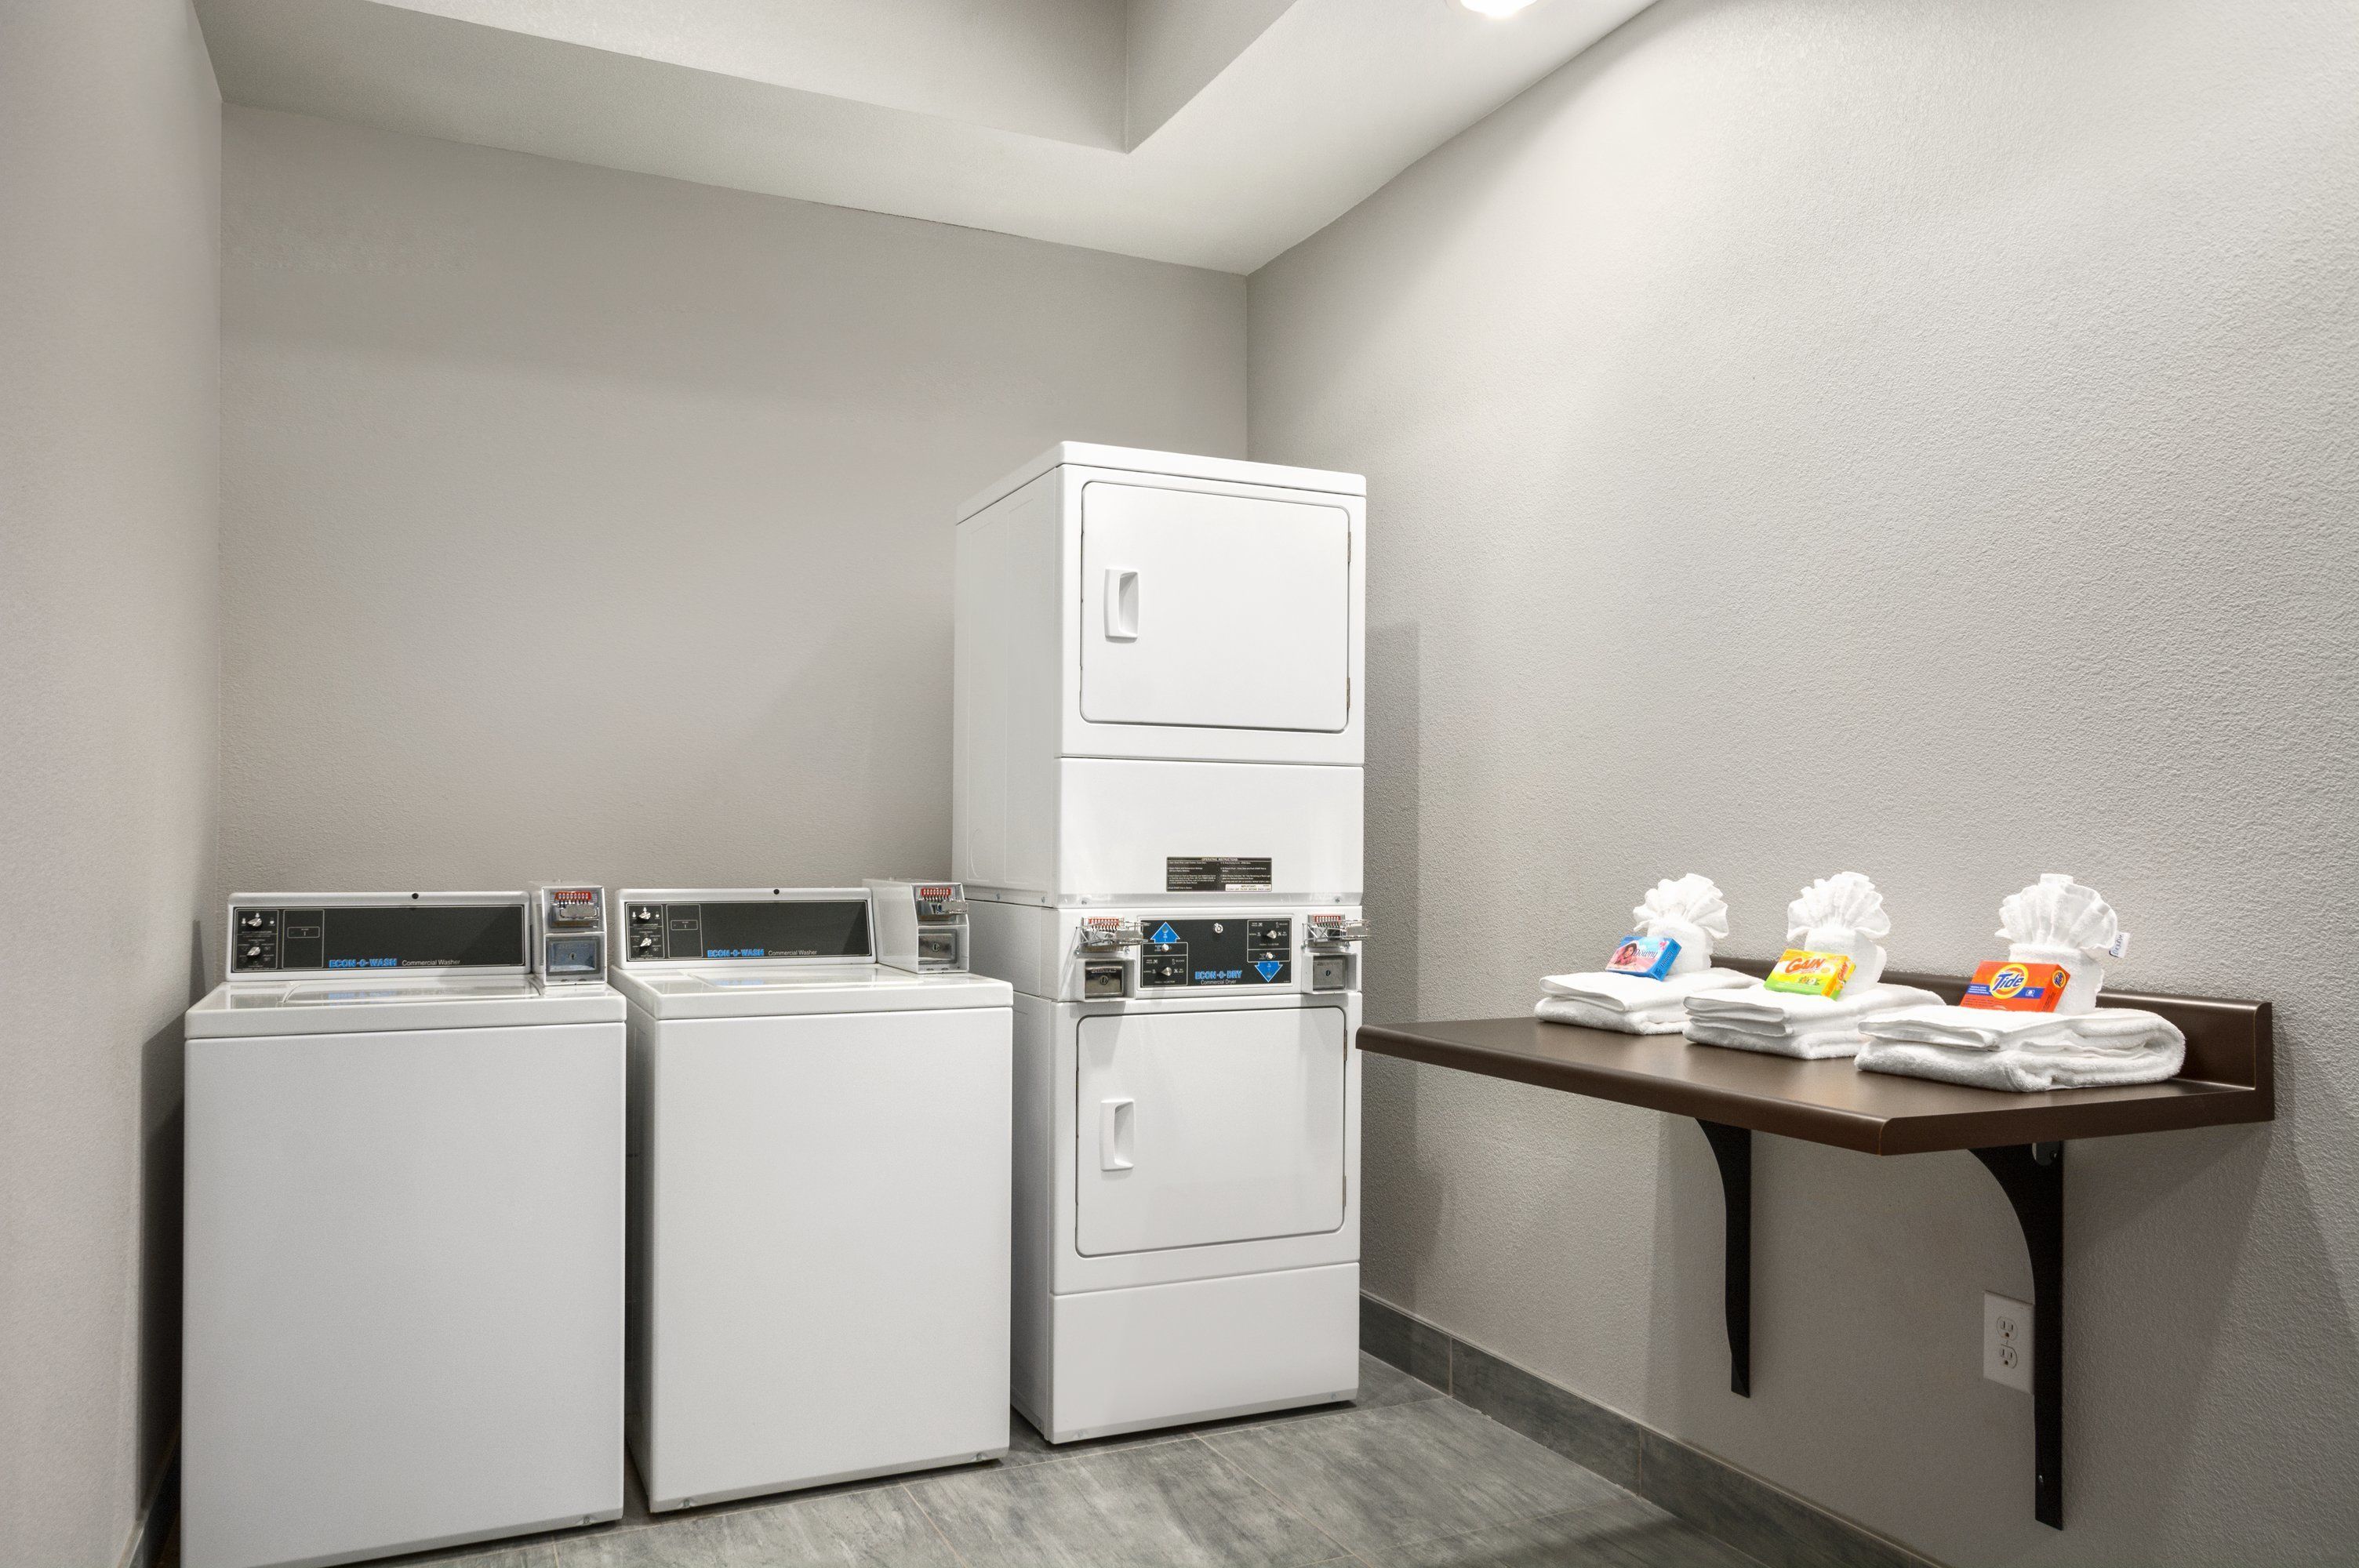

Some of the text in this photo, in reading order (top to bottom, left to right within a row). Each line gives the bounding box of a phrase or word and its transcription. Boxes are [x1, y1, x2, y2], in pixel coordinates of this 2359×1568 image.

[1633, 948, 1659, 959] Downy
[1992, 972, 2025, 992] Tide
[2053, 971, 2064, 988] Tide
